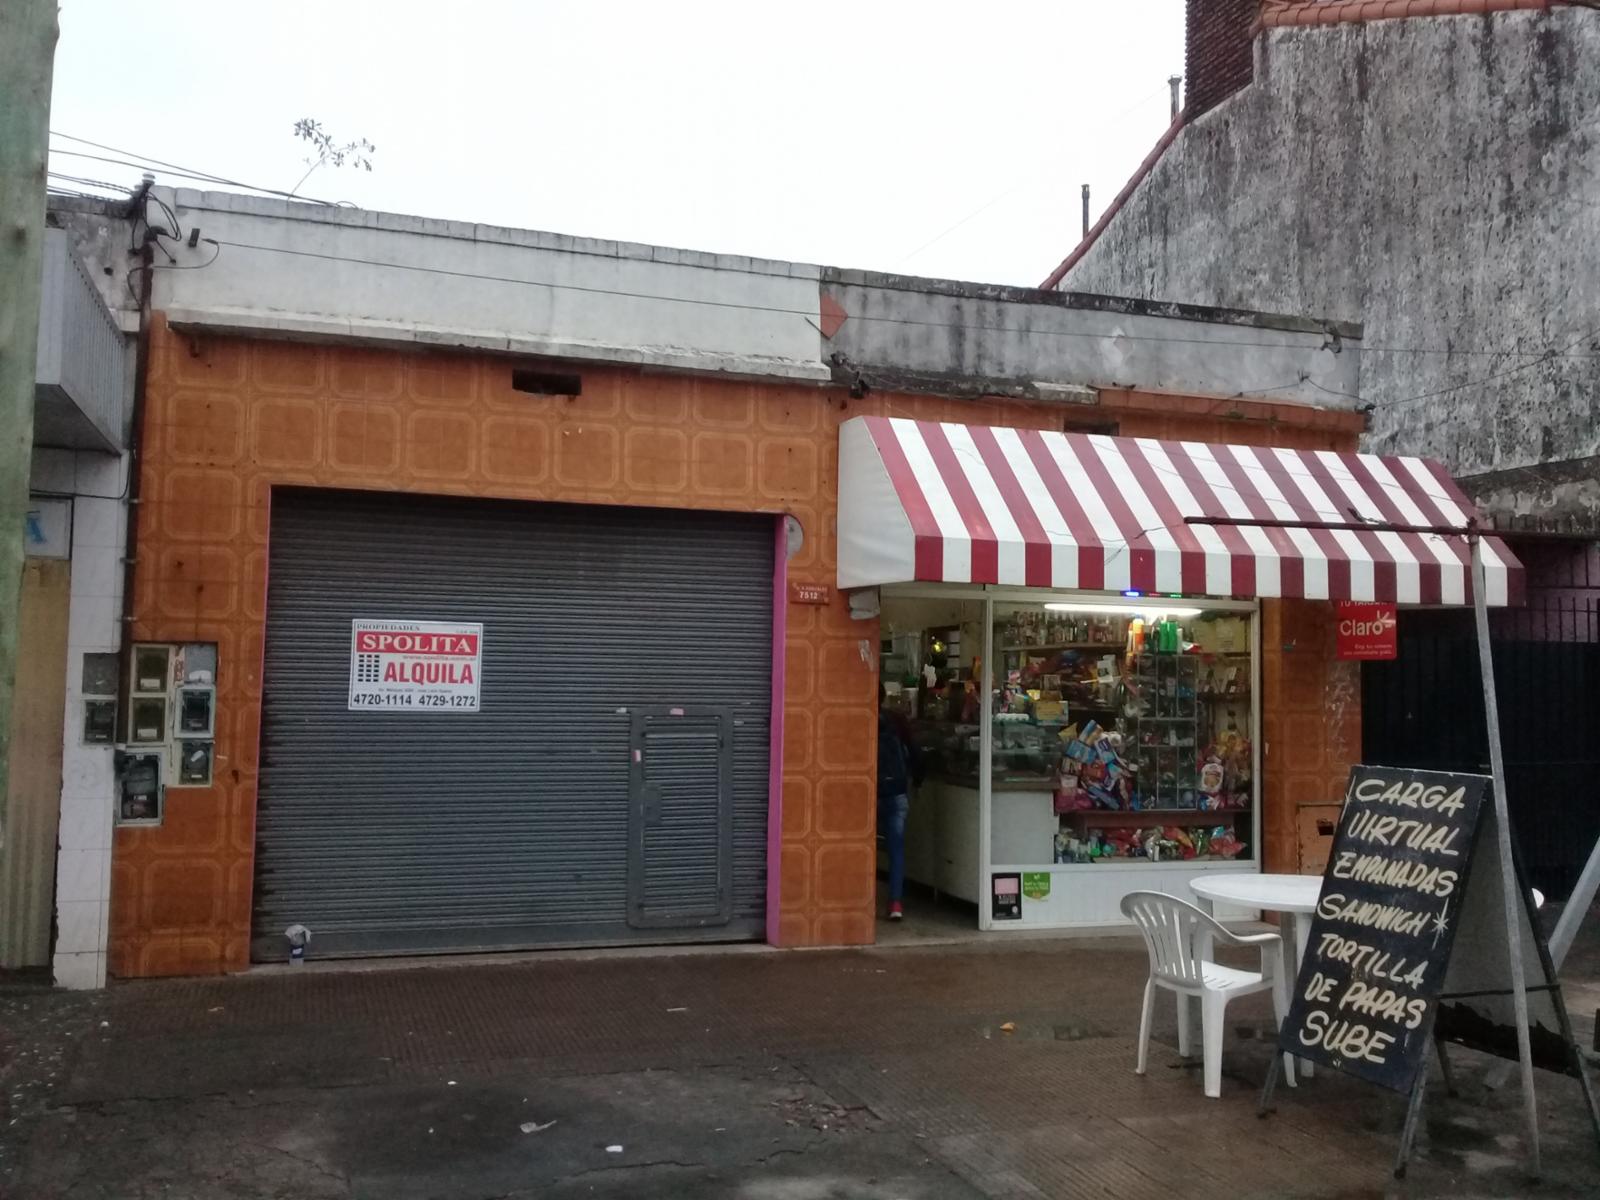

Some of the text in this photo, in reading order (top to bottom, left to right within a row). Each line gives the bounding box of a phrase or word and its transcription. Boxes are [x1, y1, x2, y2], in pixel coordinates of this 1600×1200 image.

[800, 591, 818, 600] 7512
[362, 633, 472, 653] SPOLITA
[1340, 620, 1383, 636] Claro
[383, 661, 474, 685] ALQUILA
[353, 693, 476, 707] 4720-1114 4729-1272
[1355, 779, 1466, 818] CARGA
[1333, 851, 1458, 897] EMPANADAS
[1317, 893, 1431, 937] SANDWICH
[1317, 933, 1429, 991] TORTILLA
[1304, 972, 1427, 1029] DE PAPAS
[1299, 1010, 1396, 1064] SUBE
